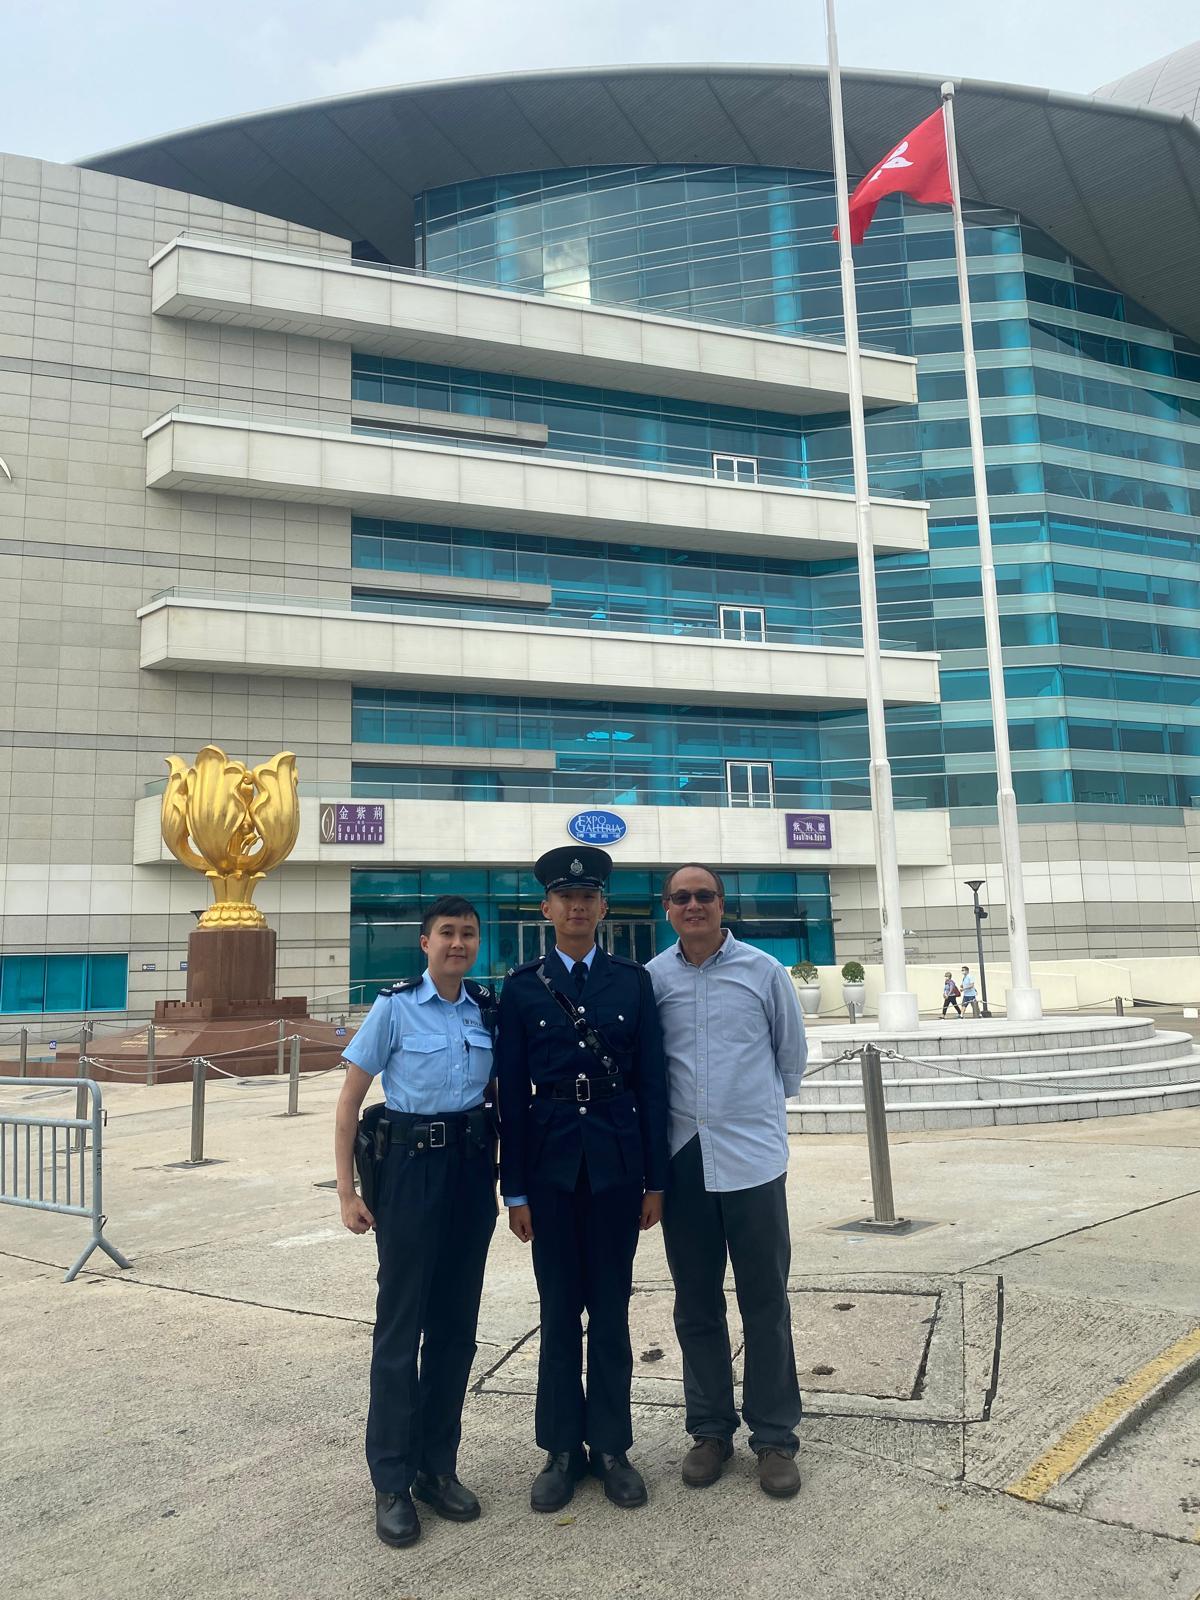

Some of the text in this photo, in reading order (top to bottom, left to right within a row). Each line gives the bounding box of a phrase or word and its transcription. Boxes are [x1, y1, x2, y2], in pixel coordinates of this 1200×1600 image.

[578, 815, 607, 825] EXPO
[338, 824, 383, 833] Golden
[575, 822, 622, 833] GALLERIA
[338, 832, 383, 841] Bauhinia
